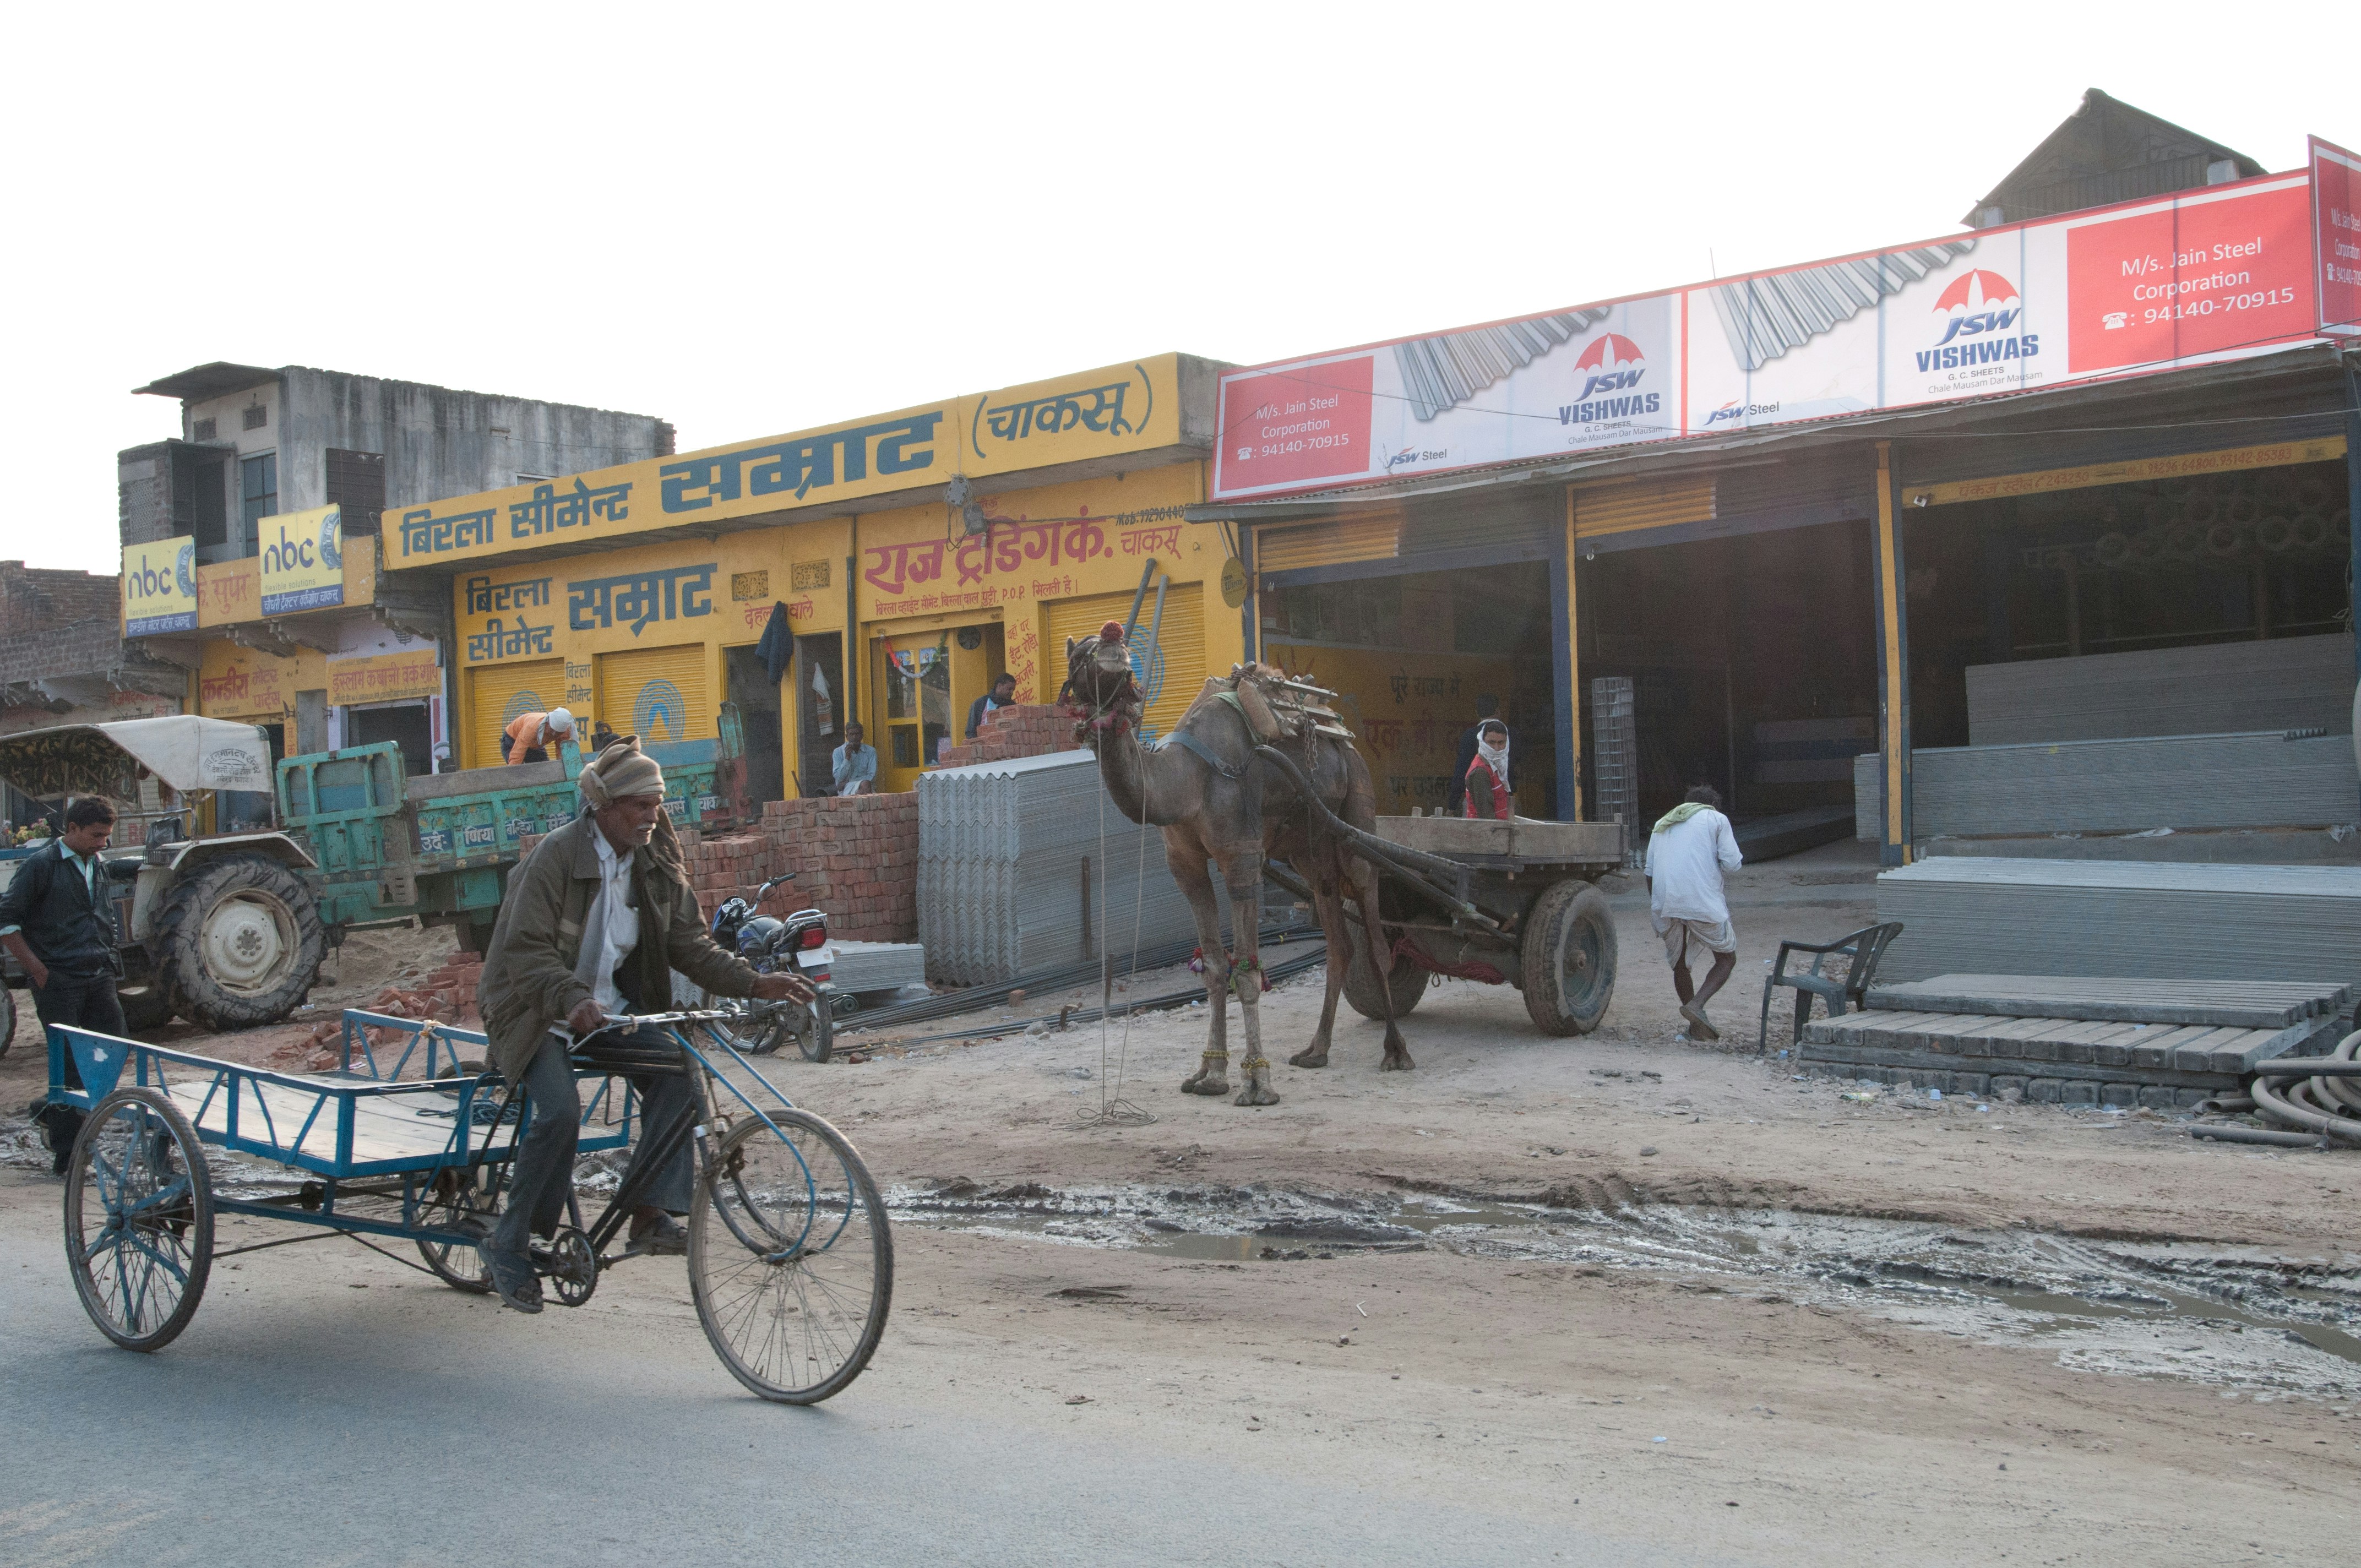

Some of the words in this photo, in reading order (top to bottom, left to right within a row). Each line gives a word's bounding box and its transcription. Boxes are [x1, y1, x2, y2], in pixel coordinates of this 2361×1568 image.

[2121, 254, 2164, 276] M/s.
[2169, 248, 2207, 268] Jain
[2212, 236, 2262, 261] Steel
[2133, 270, 2250, 301] Corporation
[2144, 286, 2295, 325] 94140-70915
[1933, 307, 2022, 347] JSW
[1915, 334, 2039, 373] VISHWAS
[1574, 368, 1646, 402] JSW
[1928, 382, 1951, 394] Chale
[1953, 379, 1988, 391] Mausam
[1990, 375, 2006, 385] Dar
[2007, 372, 2043, 383] Mausam
[1960, 371, 1968, 379] C.
[1971, 366, 2004, 378] SHEETS
[1256, 404, 1281, 420] M/s.
[1284, 400, 1306, 415] Jain
[1310, 393, 1339, 411] Steel
[1558, 393, 1660, 426] VISHWAS
[1702, 405, 1747, 426] JSW
[1749, 401, 1780, 416] Steel
[1262, 418, 1330, 438] Corporation
[1568, 435, 1587, 445] Chale
[1588, 431, 1618, 443] Mausam
[1619, 429, 1631, 439] Dar
[1633, 425, 1663, 437] Mausam
[1603, 420, 1631, 431] SHEETS
[1261, 433, 1349, 457] 94140-70915
[1387, 451, 1421, 468] JSW
[1422, 448, 1447, 461] Steel
[399, 508, 497, 557] बिरला
[509, 476, 633, 539] सीमेन्ट
[659, 410, 943, 514] सम्राट
[264, 526, 315, 574] nbc
[864, 538, 947, 595] राज
[956, 514, 1064, 588] ट्रडिंग
[1120, 524, 1183, 560] चाकसू
[128, 554, 172, 600] nbc
[265, 582, 286, 592] flexible
[289, 578, 316, 589] solutions
[129, 607, 148, 617] flexible
[149, 605, 174, 614] solutions
[465, 576, 553, 616] बिरला
[567, 562, 717, 638] सम्राट
[789, 594, 813, 620] वाले
[467, 614, 554, 661] सीमेन्ट
[565, 661, 592, 679] बिरला
[566, 684, 592, 704] सीमेन्ट
